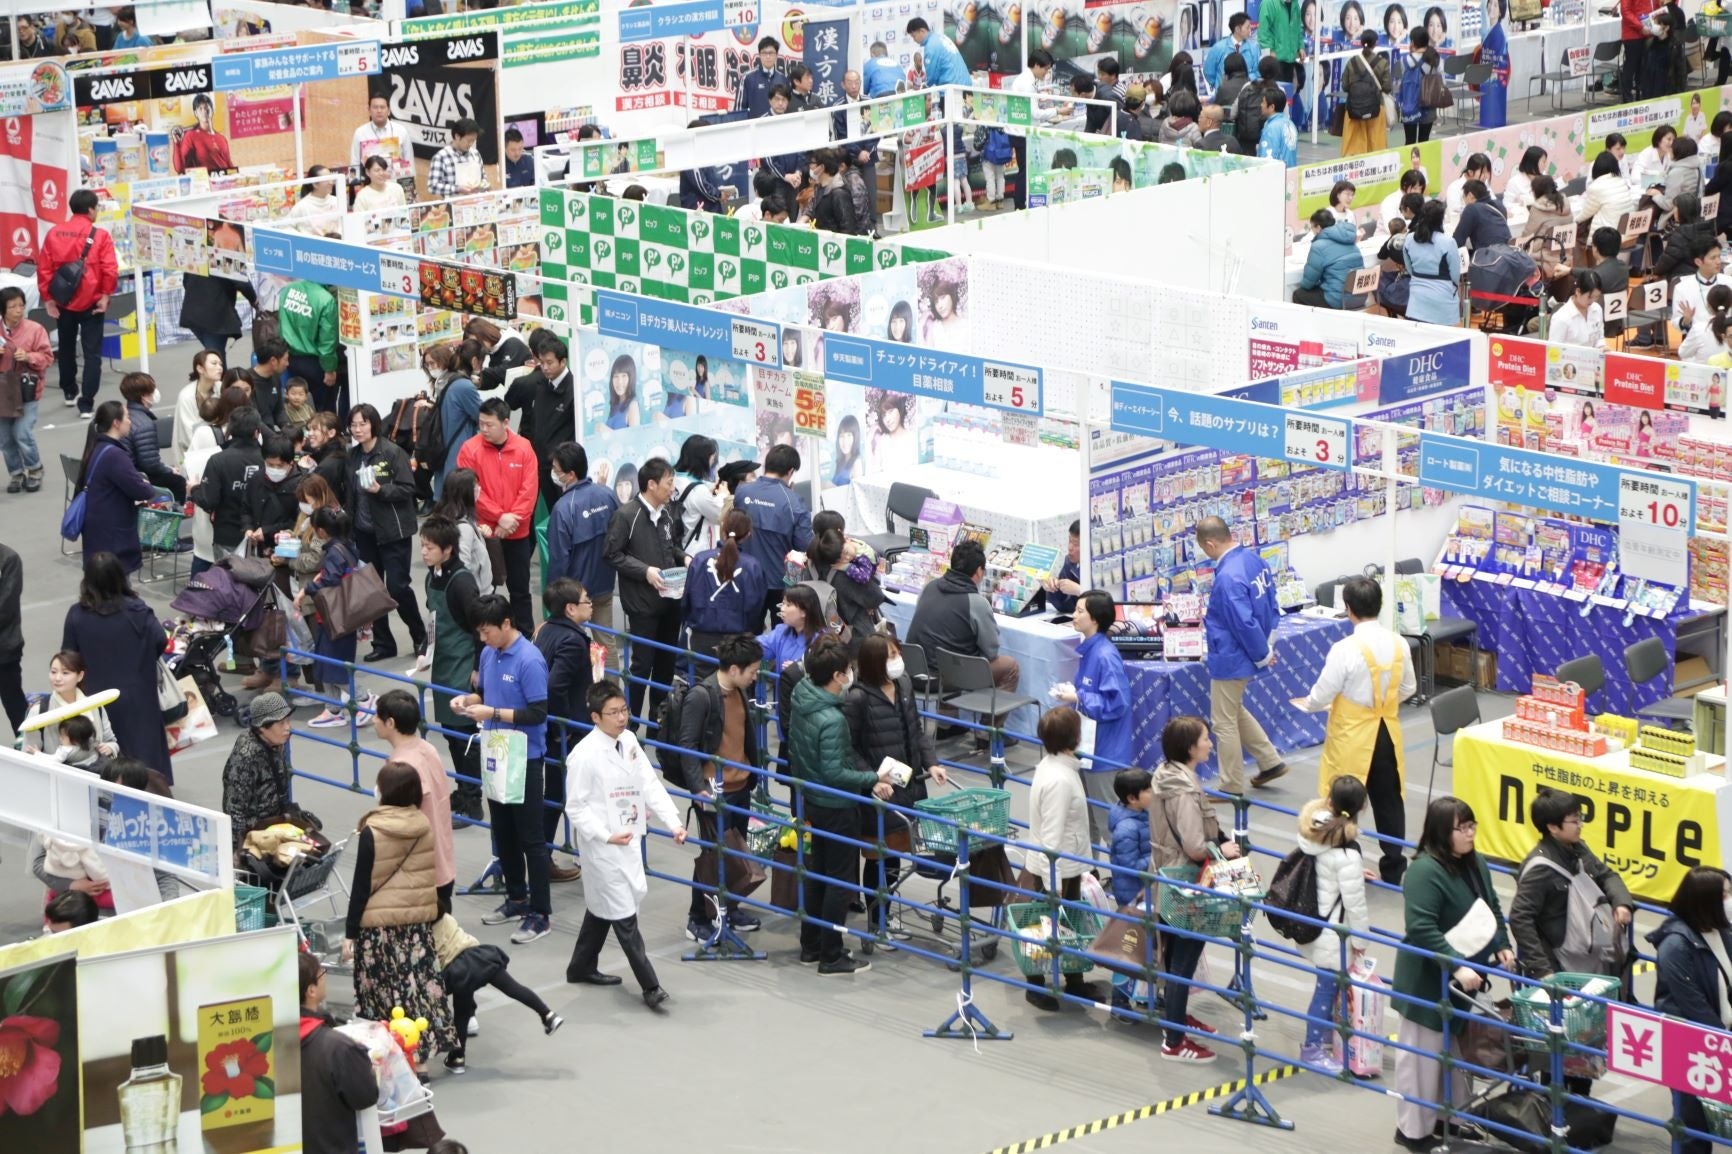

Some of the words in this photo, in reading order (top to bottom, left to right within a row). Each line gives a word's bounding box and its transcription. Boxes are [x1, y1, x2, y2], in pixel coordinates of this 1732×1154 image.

[657, 10, 719, 26] クラシエの漢方相談
[737, 10, 754, 24] 10
[381, 45, 420, 68] SAVAS
[447, 37, 485, 60] SAVAS
[254, 50, 335, 69] 家族みんなをサポートする
[358, 57, 367, 71] 5
[622, 45, 665, 89] 鼻炎
[813, 28, 839, 105] 漢方薬
[165, 68, 208, 92] SAVAS
[268, 65, 324, 81] 栄養食品のご案内
[90, 77, 135, 100] SAVAS
[389, 73, 475, 127] SAVAS
[621, 94, 666, 110] 漢方相談
[1591, 106, 1650, 123] 私たちはお客様の毎日の
[1616, 109, 1679, 128] 健康と美容を応援します！
[421, 130, 447, 144] ザバス
[1304, 160, 1365, 178] 私たちはお客様の毎日の
[296, 249, 377, 275] 肩の筋硬度測定サービス
[380, 258, 404, 270] 所要時間
[404, 263, 419, 272] お一人
[382, 281, 397, 289] およそ
[401, 275, 412, 294] 3
[1649, 288, 1662, 303] 3
[1610, 299, 1622, 315] 2
[340, 322, 361, 338] OFF
[640, 313, 729, 341] 目ヂカラ美人にチャレンジ！
[732, 323, 758, 337] 所要時間
[1251, 316, 1279, 331] Santen
[1367, 333, 1396, 348] Santen
[733, 347, 749, 357] およそ
[754, 342, 766, 361] 3
[771, 355, 777, 363] 分
[1509, 354, 1526, 364] DHC
[876, 349, 977, 378] チェックドライアイ！
[1252, 359, 1296, 373] ソフトサンティア
[1408, 351, 1444, 376] DHC
[1497, 361, 1521, 373] Protein
[1522, 364, 1537, 375] Diet
[758, 368, 787, 383] 目ヂカラ
[912, 373, 954, 394] 目薬相談
[984, 366, 1015, 382] 所要時間
[1015, 375, 1038, 386] お一人様
[1626, 372, 1643, 381] DHC
[756, 380, 791, 397] 美人ゲーム
[1613, 378, 1638, 391] Protein
[1639, 382, 1655, 393] Diet
[766, 398, 784, 408] 実施中
[985, 391, 1004, 403] およそ
[1011, 386, 1024, 407] 5
[1031, 400, 1038, 409] 分
[796, 412, 826, 429] OFF
[1167, 406, 1280, 440] 今、話題のサプリは？
[1286, 418, 1320, 434] 所要時間
[1321, 427, 1346, 438] お一人様
[1286, 446, 1307, 457] およそ
[1315, 439, 1330, 462] 3
[1337, 454, 1345, 464] 分
[1499, 456, 1600, 487] 気になる中性脂肪や
[1482, 476, 1615, 509] ダイエットご相談コーナー
[1621, 478, 1660, 496] 所要時間
[1660, 488, 1689, 501] お一人様
[1620, 507, 1643, 520] およそ
[1647, 500, 1679, 527] 10
[1680, 518, 1688, 528] 分
[1580, 531, 1607, 547] DHC
[1532, 763, 1670, 808] 中性脂肪の上昇を抑える
[1603, 853, 1658, 879] ドリンク
[209, 1006, 260, 1026] 大島椿
[1620, 1022, 1655, 1067] ¥
